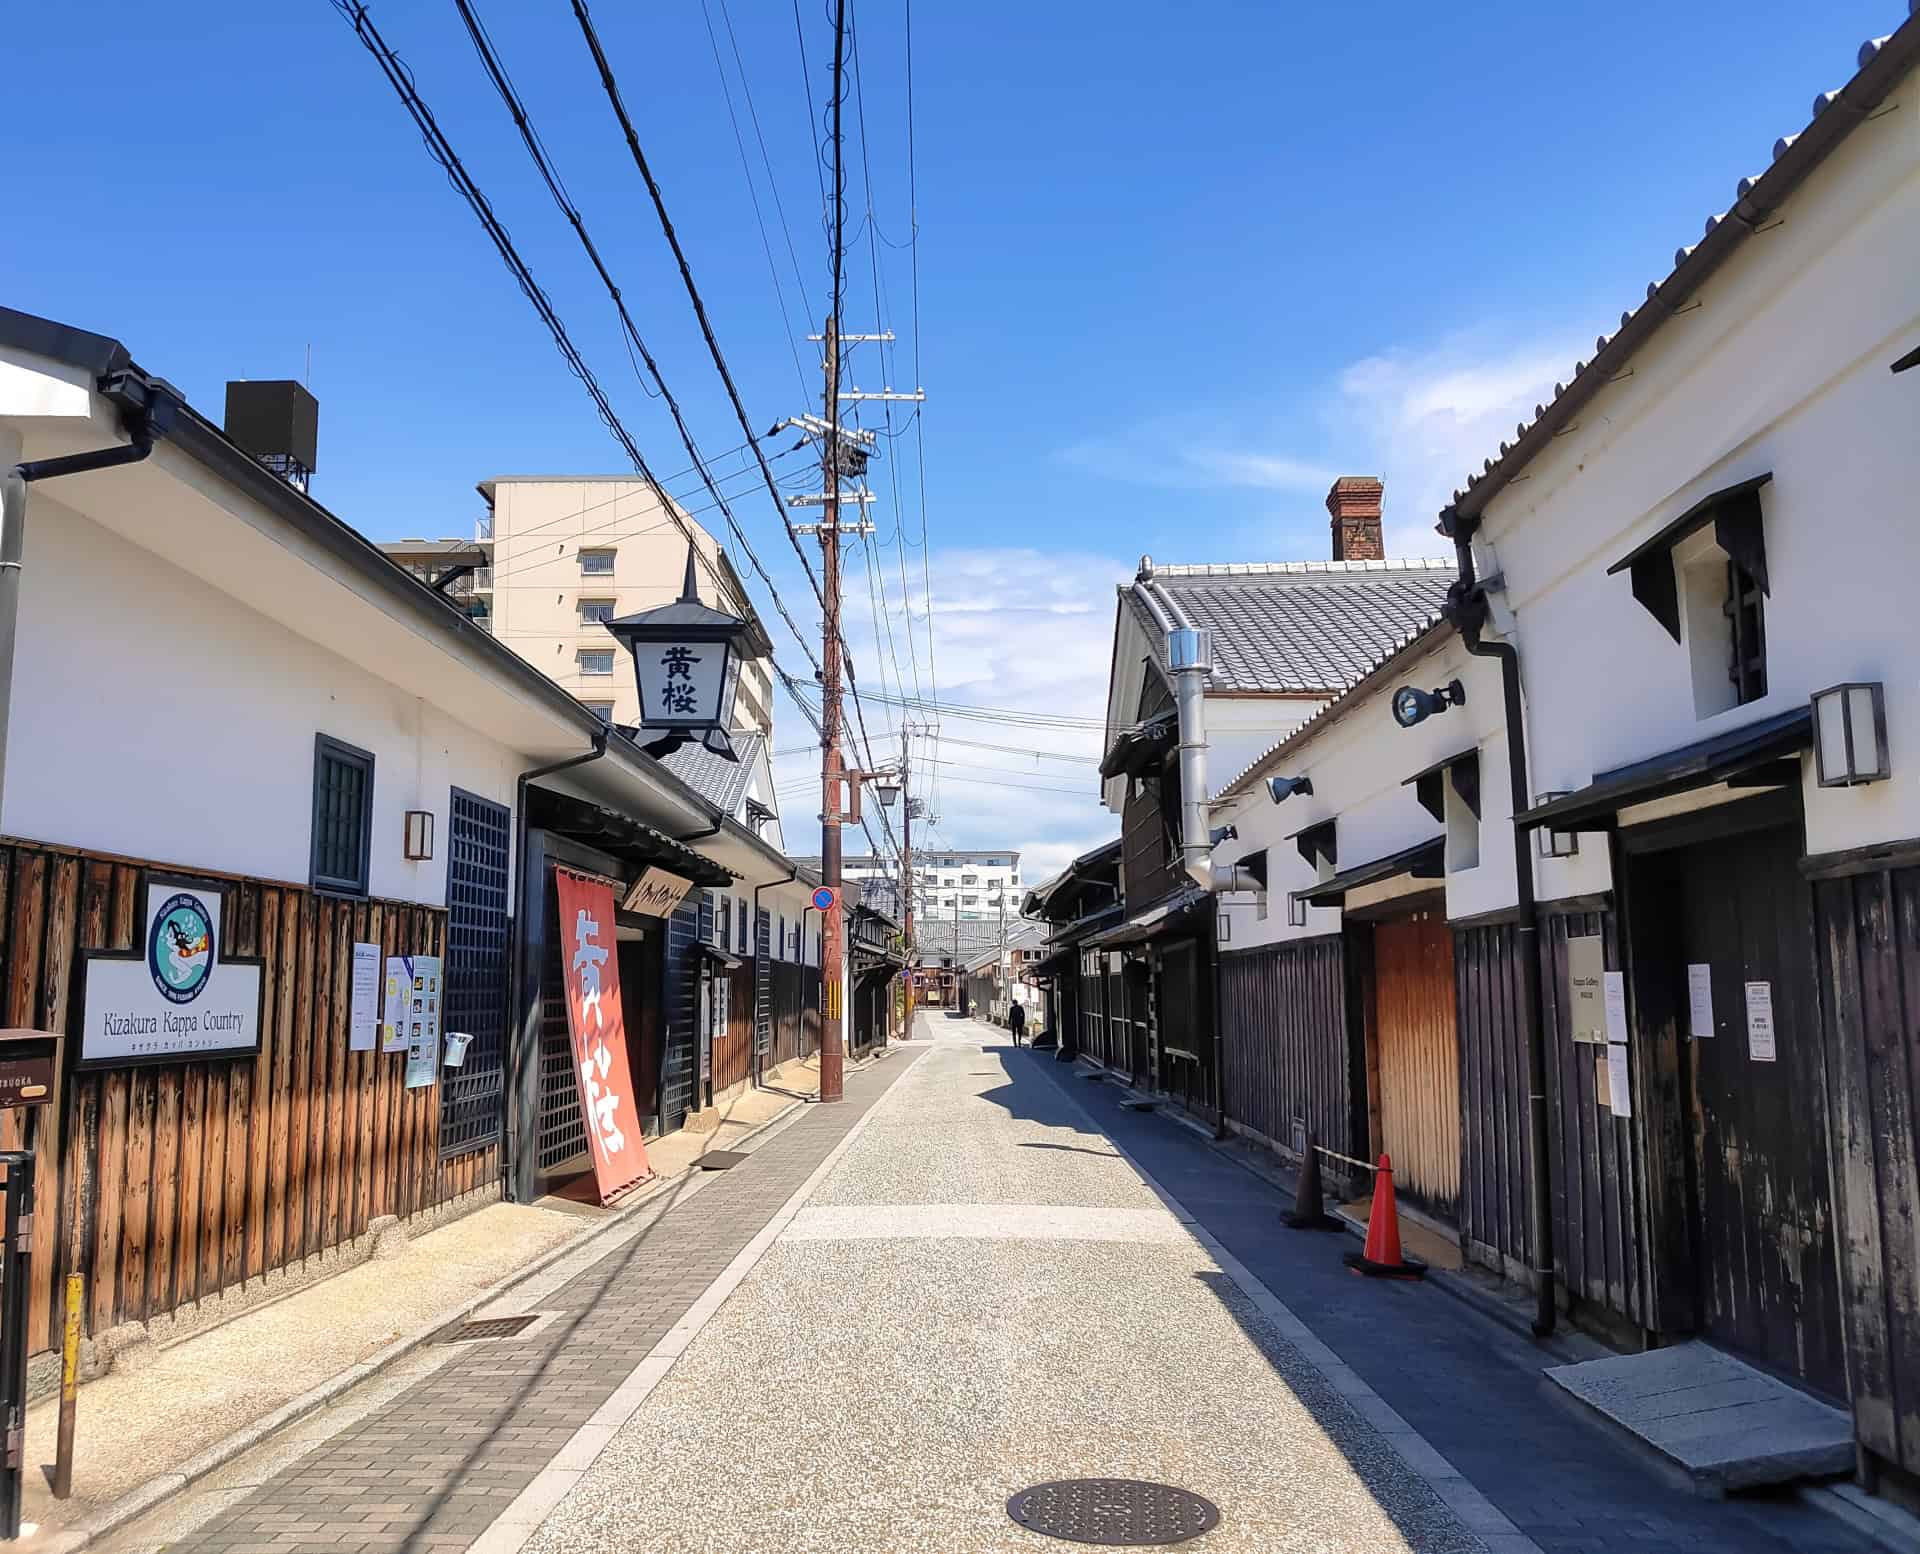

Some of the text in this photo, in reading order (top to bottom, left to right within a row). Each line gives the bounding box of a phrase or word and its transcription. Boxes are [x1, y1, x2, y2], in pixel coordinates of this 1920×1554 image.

[661, 646, 702, 715] 黄桜
[103, 1009, 244, 1038] Kizakura Kappa Country
